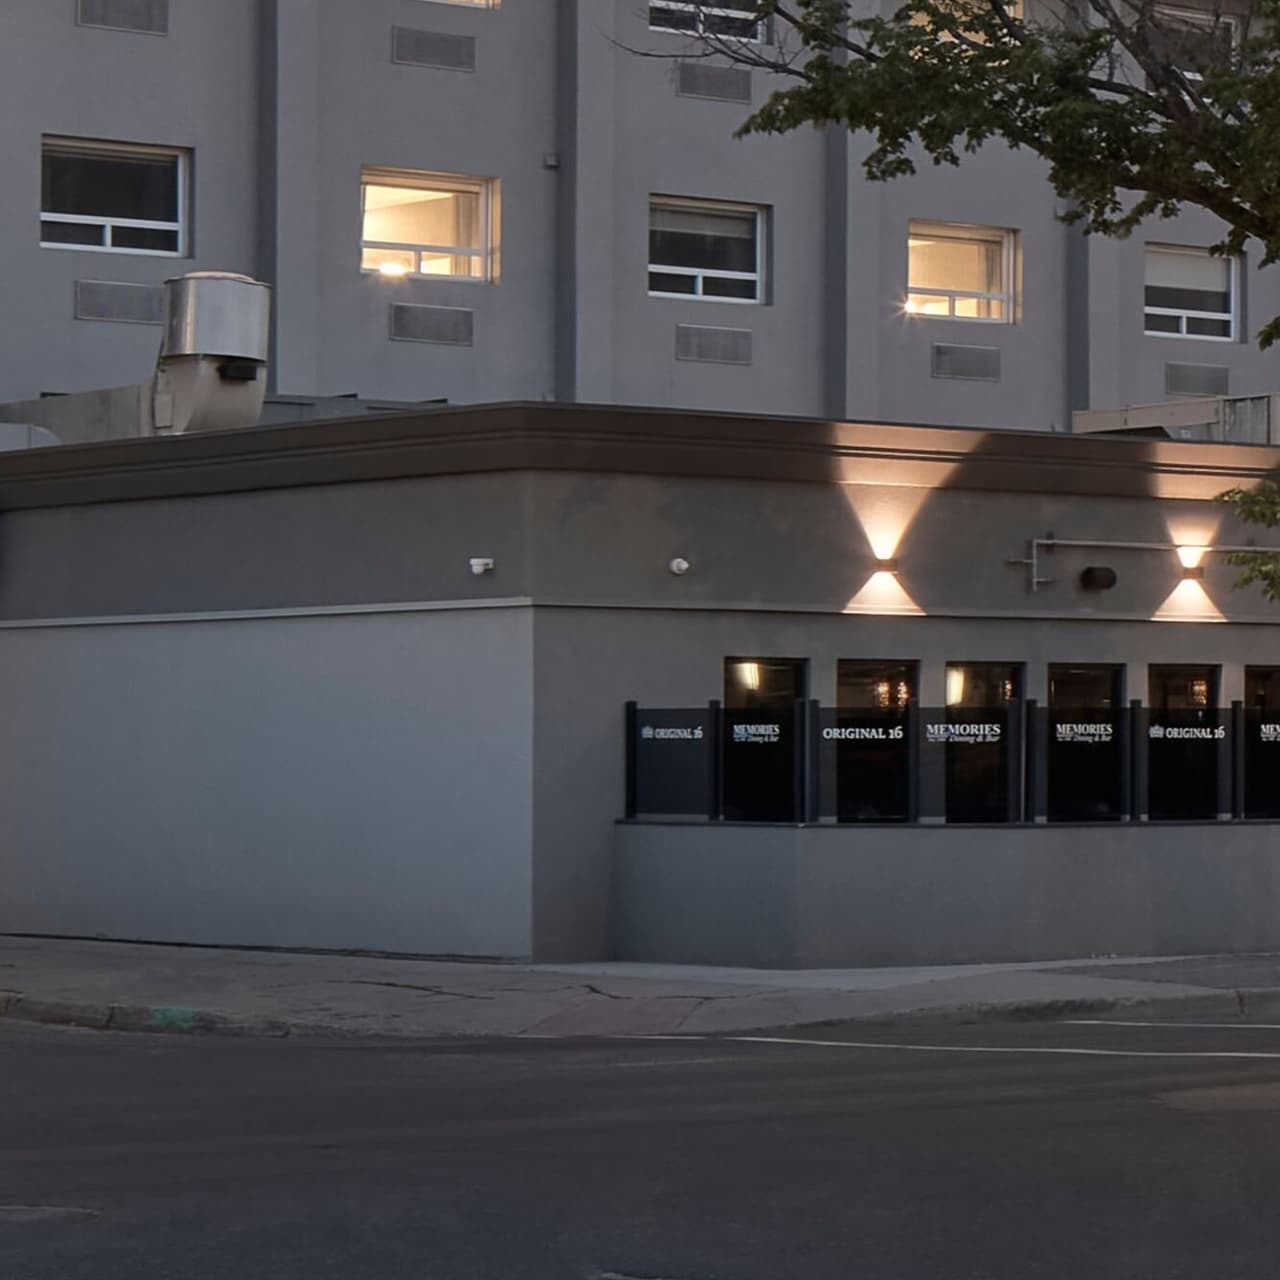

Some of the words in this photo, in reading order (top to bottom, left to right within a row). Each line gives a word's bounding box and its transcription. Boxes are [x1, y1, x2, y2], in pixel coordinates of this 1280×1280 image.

[655, 728, 693, 739] ORIGINAL
[733, 724, 780, 735] MEMORIES
[823, 728, 886, 739] ORIGINAL
[888, 726, 903, 739] 16
[926, 724, 1001, 735] MEMORIES
[1056, 724, 1113, 735] MEMORIES
[1166, 728, 1212, 739] ORIGINAL
[1214, 726, 1225, 739] 16
